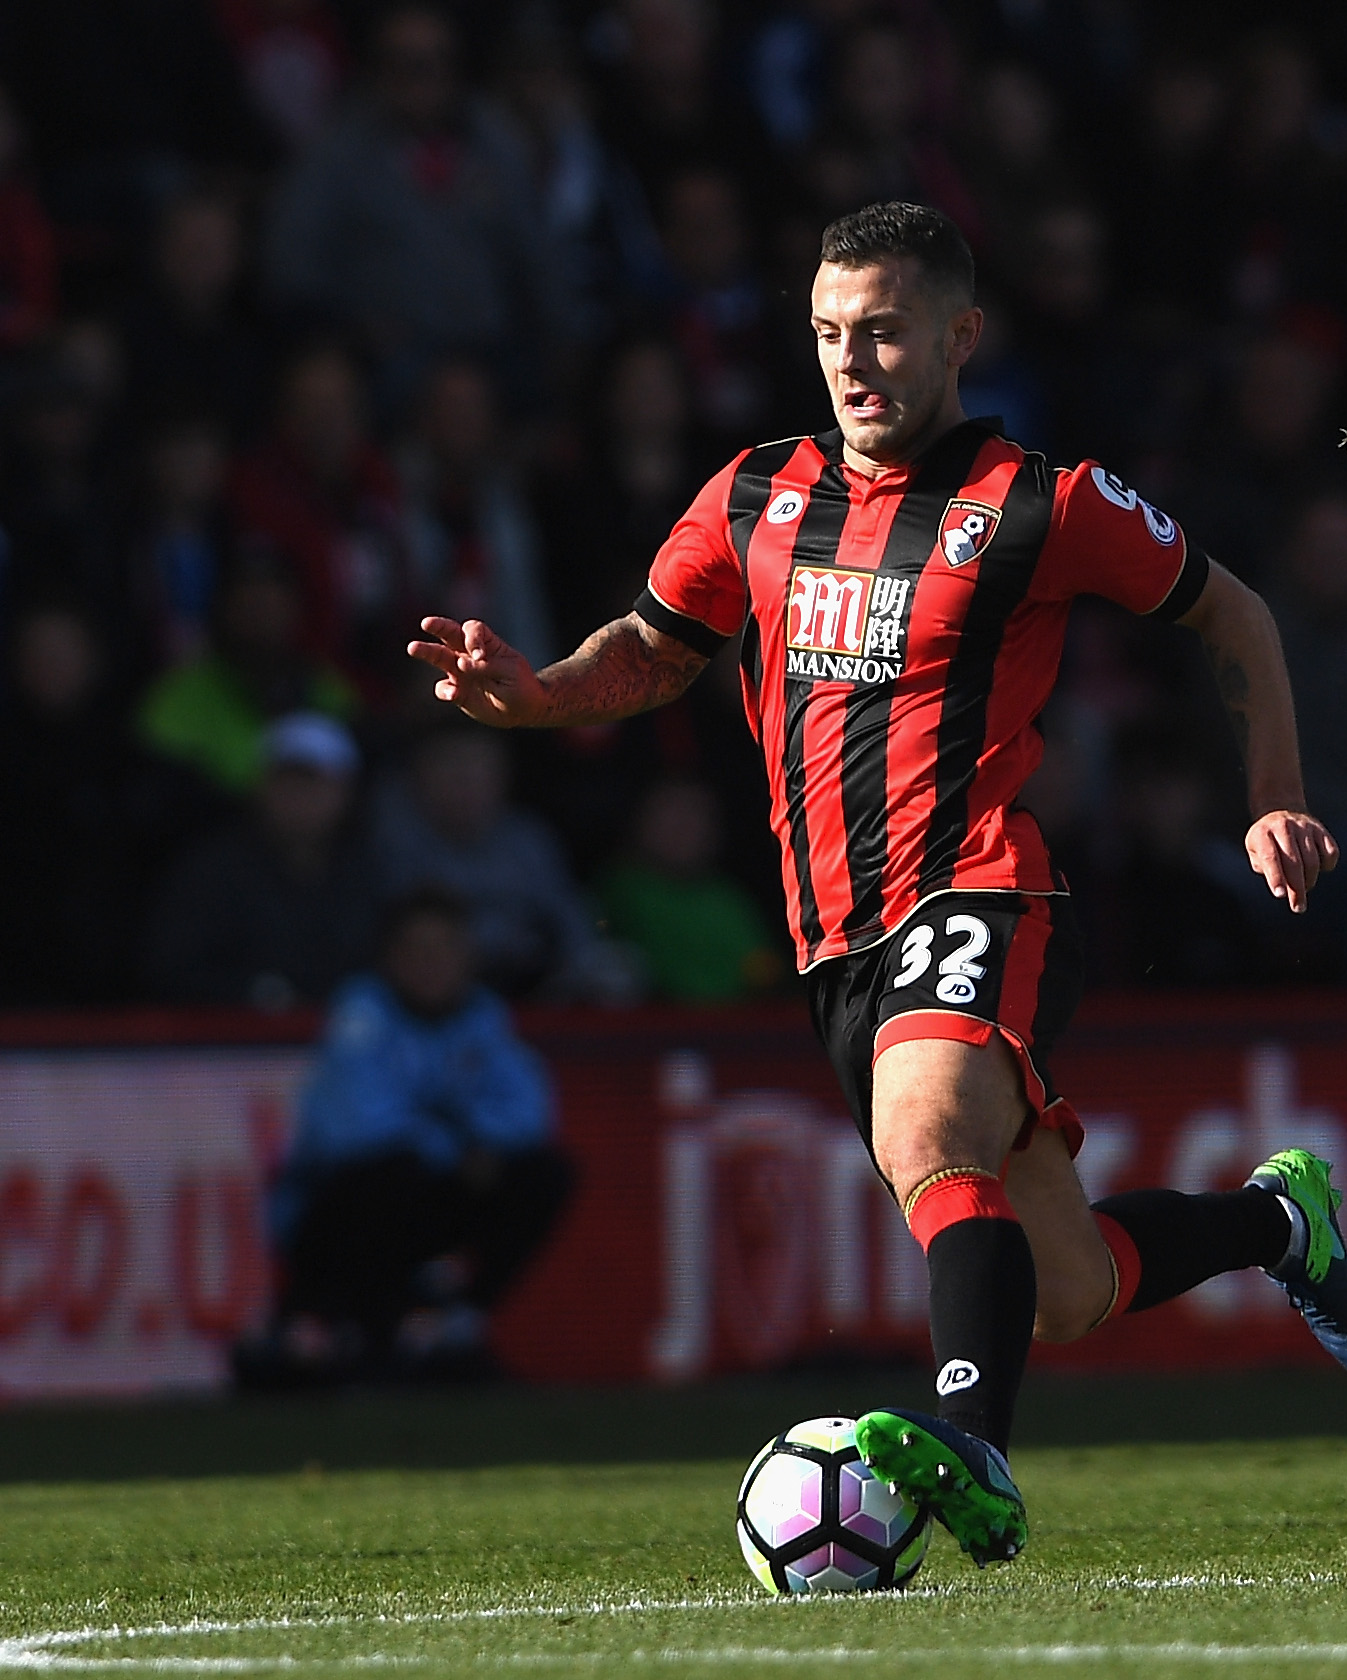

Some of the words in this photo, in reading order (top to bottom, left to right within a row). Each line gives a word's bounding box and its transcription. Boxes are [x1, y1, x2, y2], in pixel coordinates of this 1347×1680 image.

[773, 502, 797, 516] JD
[786, 650, 903, 684] MANSION
[893, 914, 991, 989] 32
[944, 983, 971, 997] JD
[942, 1366, 973, 1390] JD
